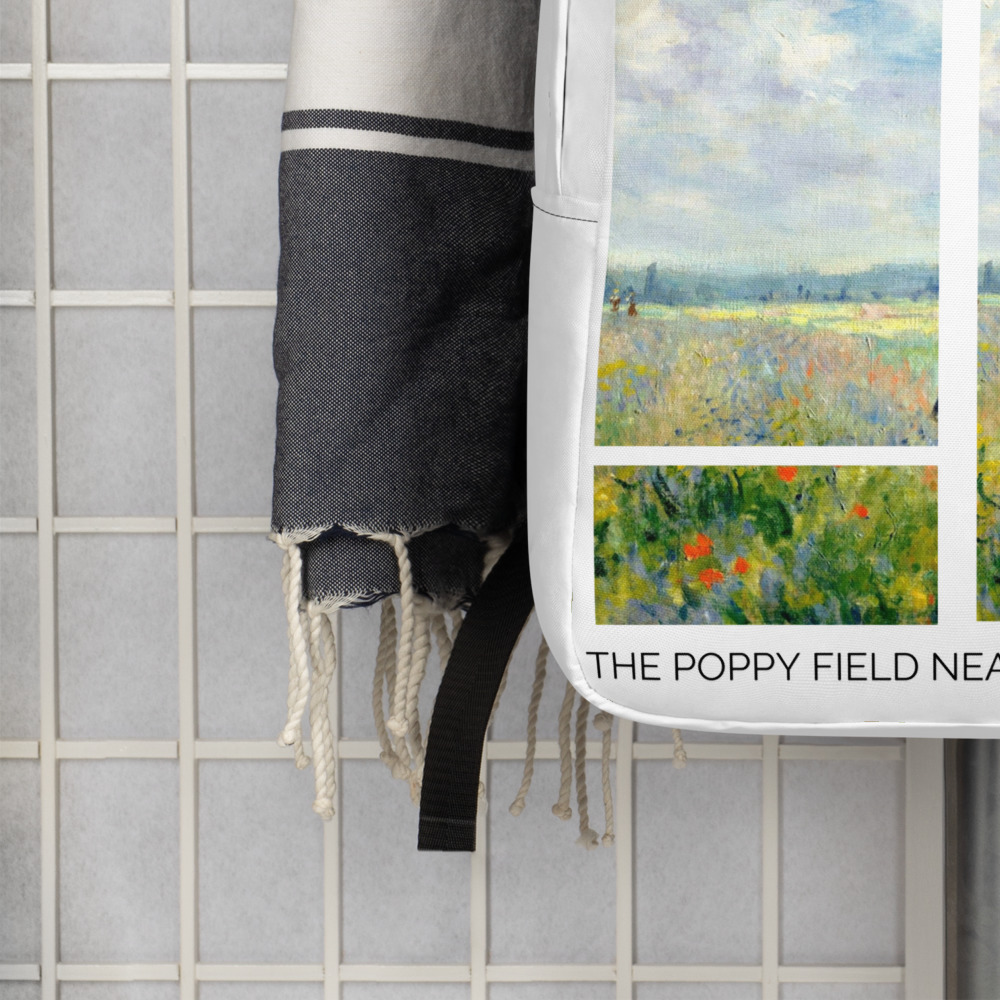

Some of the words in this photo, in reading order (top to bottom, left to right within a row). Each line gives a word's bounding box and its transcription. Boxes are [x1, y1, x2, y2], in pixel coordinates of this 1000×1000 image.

[586, 652, 661, 680] THE
[675, 653, 800, 681] POPPY
[814, 653, 918, 681] FIELD
